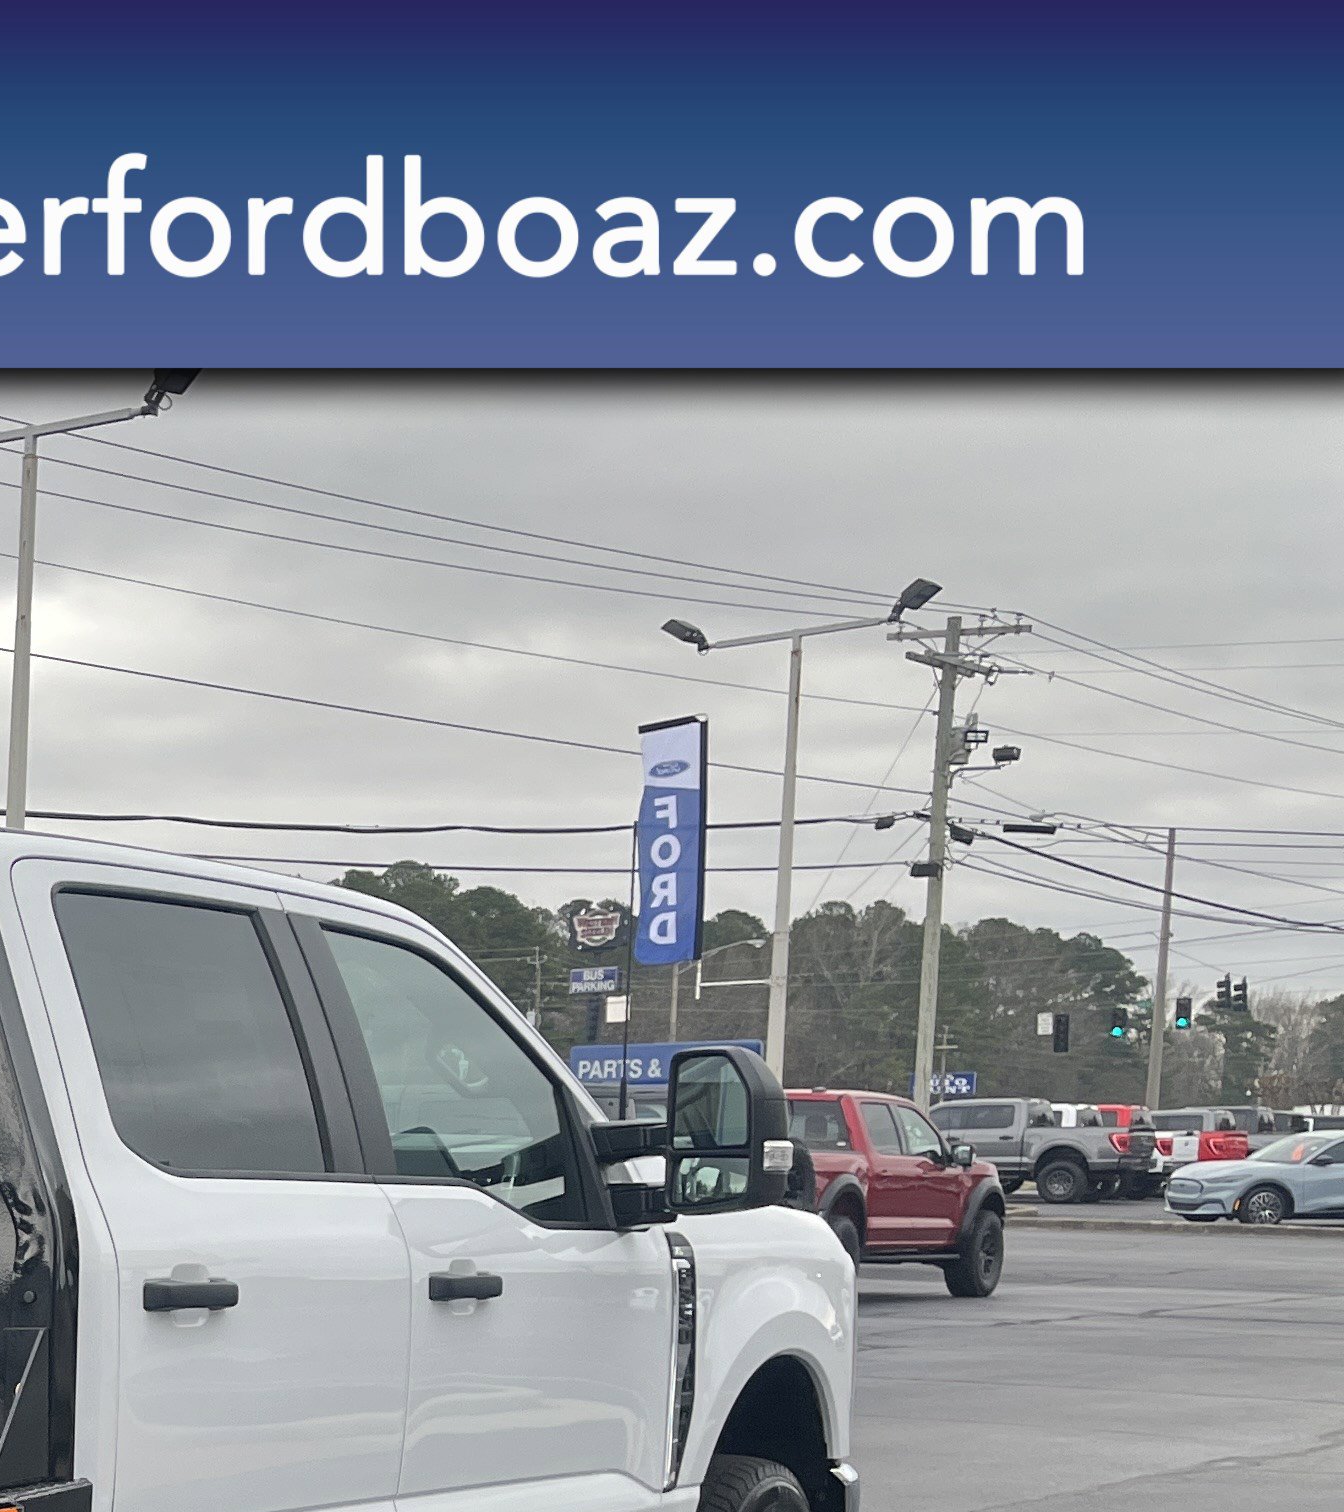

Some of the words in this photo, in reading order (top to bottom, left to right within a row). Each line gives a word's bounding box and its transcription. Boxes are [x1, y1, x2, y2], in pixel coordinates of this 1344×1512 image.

[583, 969, 605, 980] BUS
[571, 980, 615, 992] PARKING
[578, 1059, 643, 1080] PARTS
[647, 1058, 662, 1079] &
